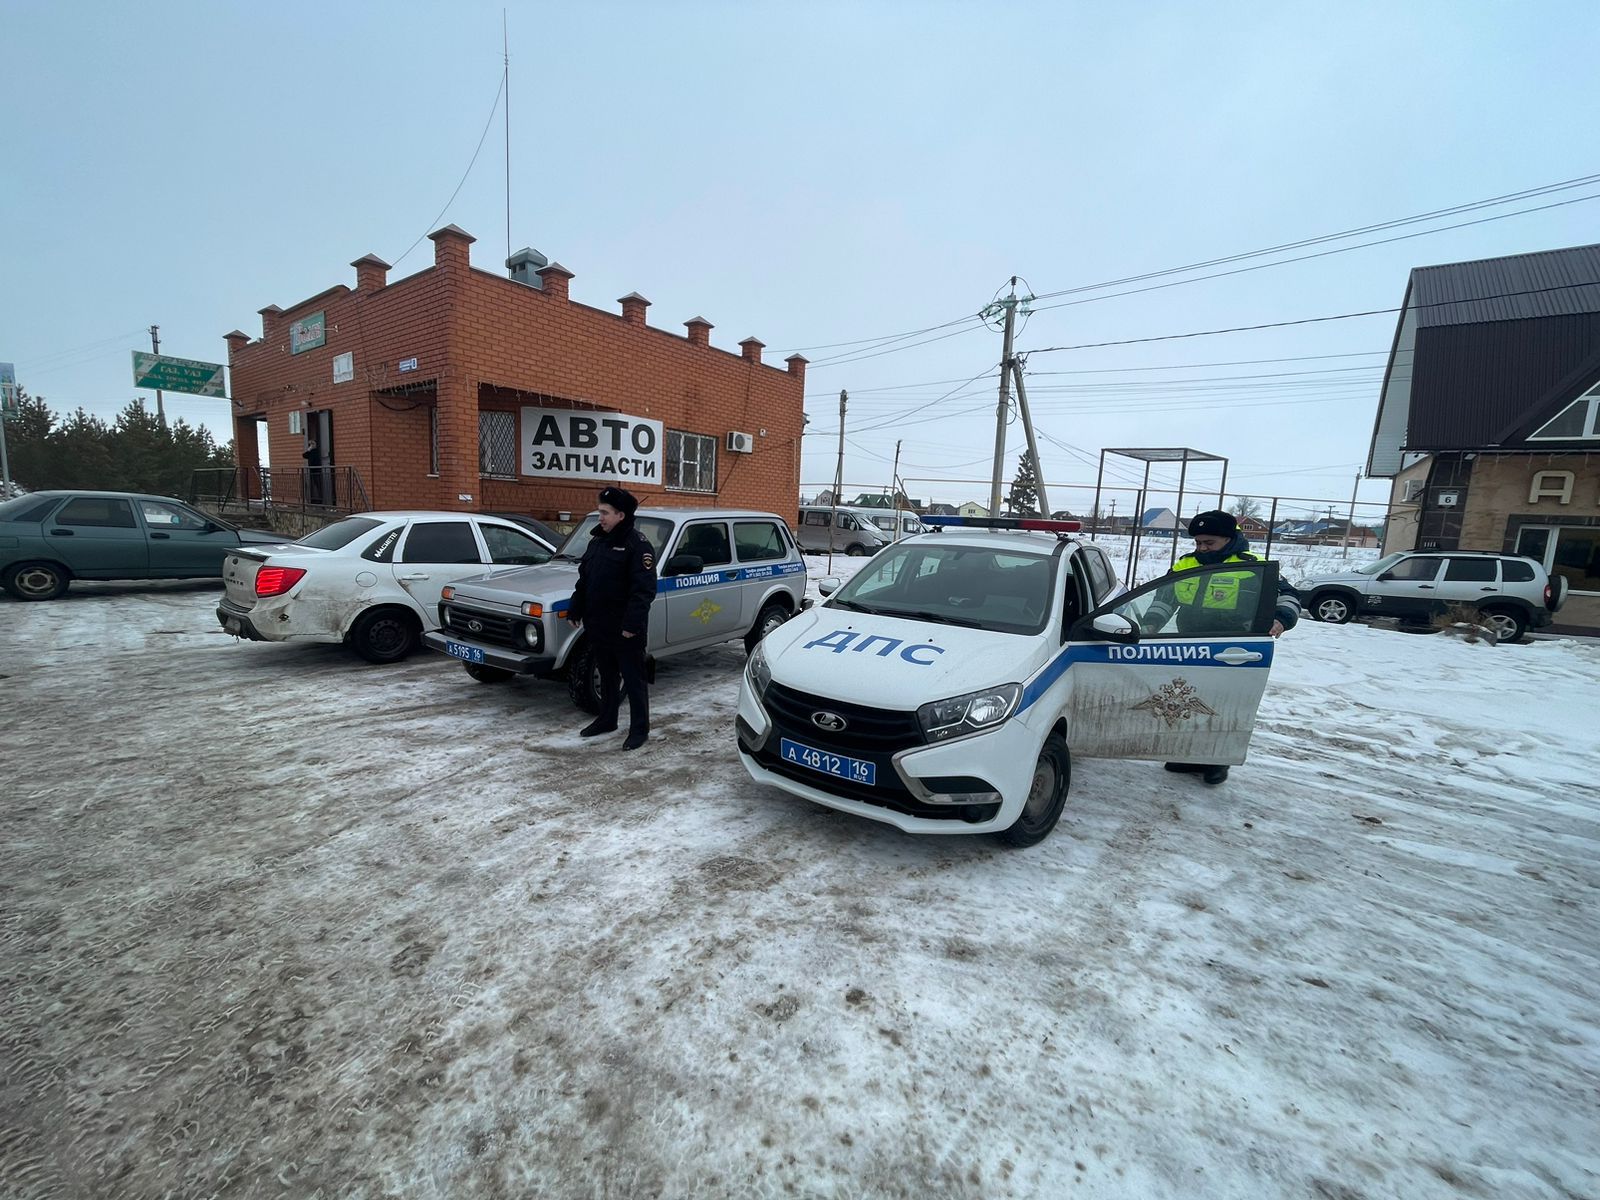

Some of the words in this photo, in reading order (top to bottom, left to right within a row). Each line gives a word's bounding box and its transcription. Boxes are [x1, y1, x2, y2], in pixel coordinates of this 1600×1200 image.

[532, 415, 656, 455] АВТО
[532, 451, 656, 478] ЗАПЧАСТИ
[1528, 470, 1600, 505] А
[676, 573, 720, 588] ПОЛИЦИЯ
[454, 644, 470, 659] 5195
[473, 649, 481, 659] 16
[802, 630, 946, 665] ДПС
[1108, 646, 1211, 662] ПОЛИЦИЯ
[788, 747, 797, 760] А
[802, 749, 841, 774] 4812
[852, 761, 869, 776] 16
[853, 773, 867, 782] RUS
